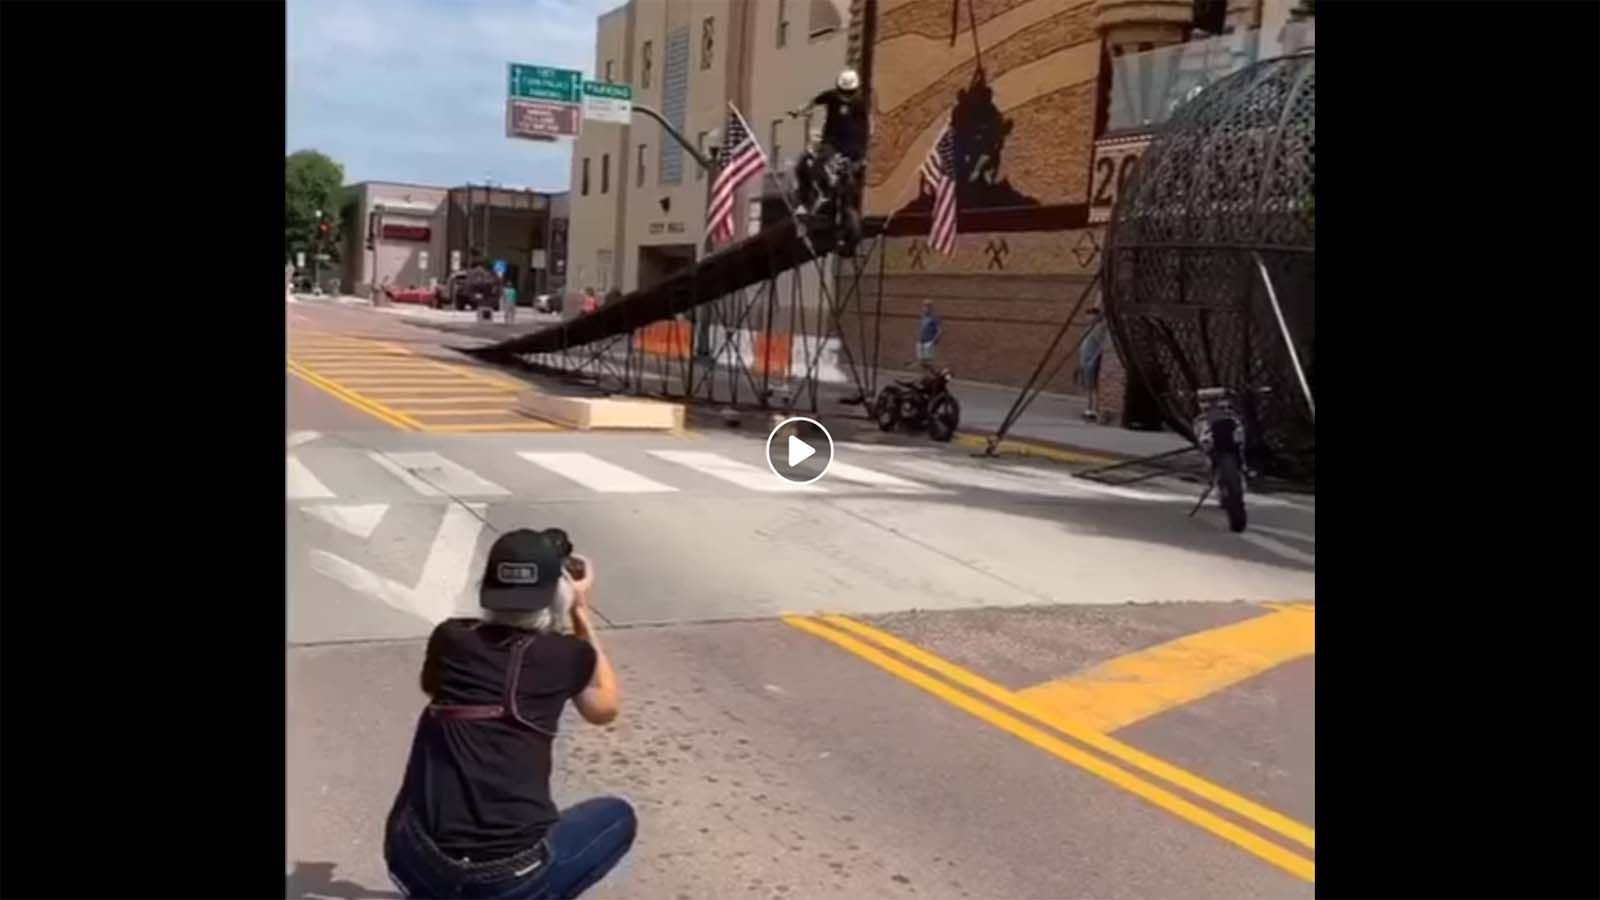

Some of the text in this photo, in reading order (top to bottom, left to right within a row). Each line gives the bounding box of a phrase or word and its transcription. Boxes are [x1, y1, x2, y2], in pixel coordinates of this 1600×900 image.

[586, 83, 629, 98] PARKING
[649, 222, 685, 234] CITY HALL
